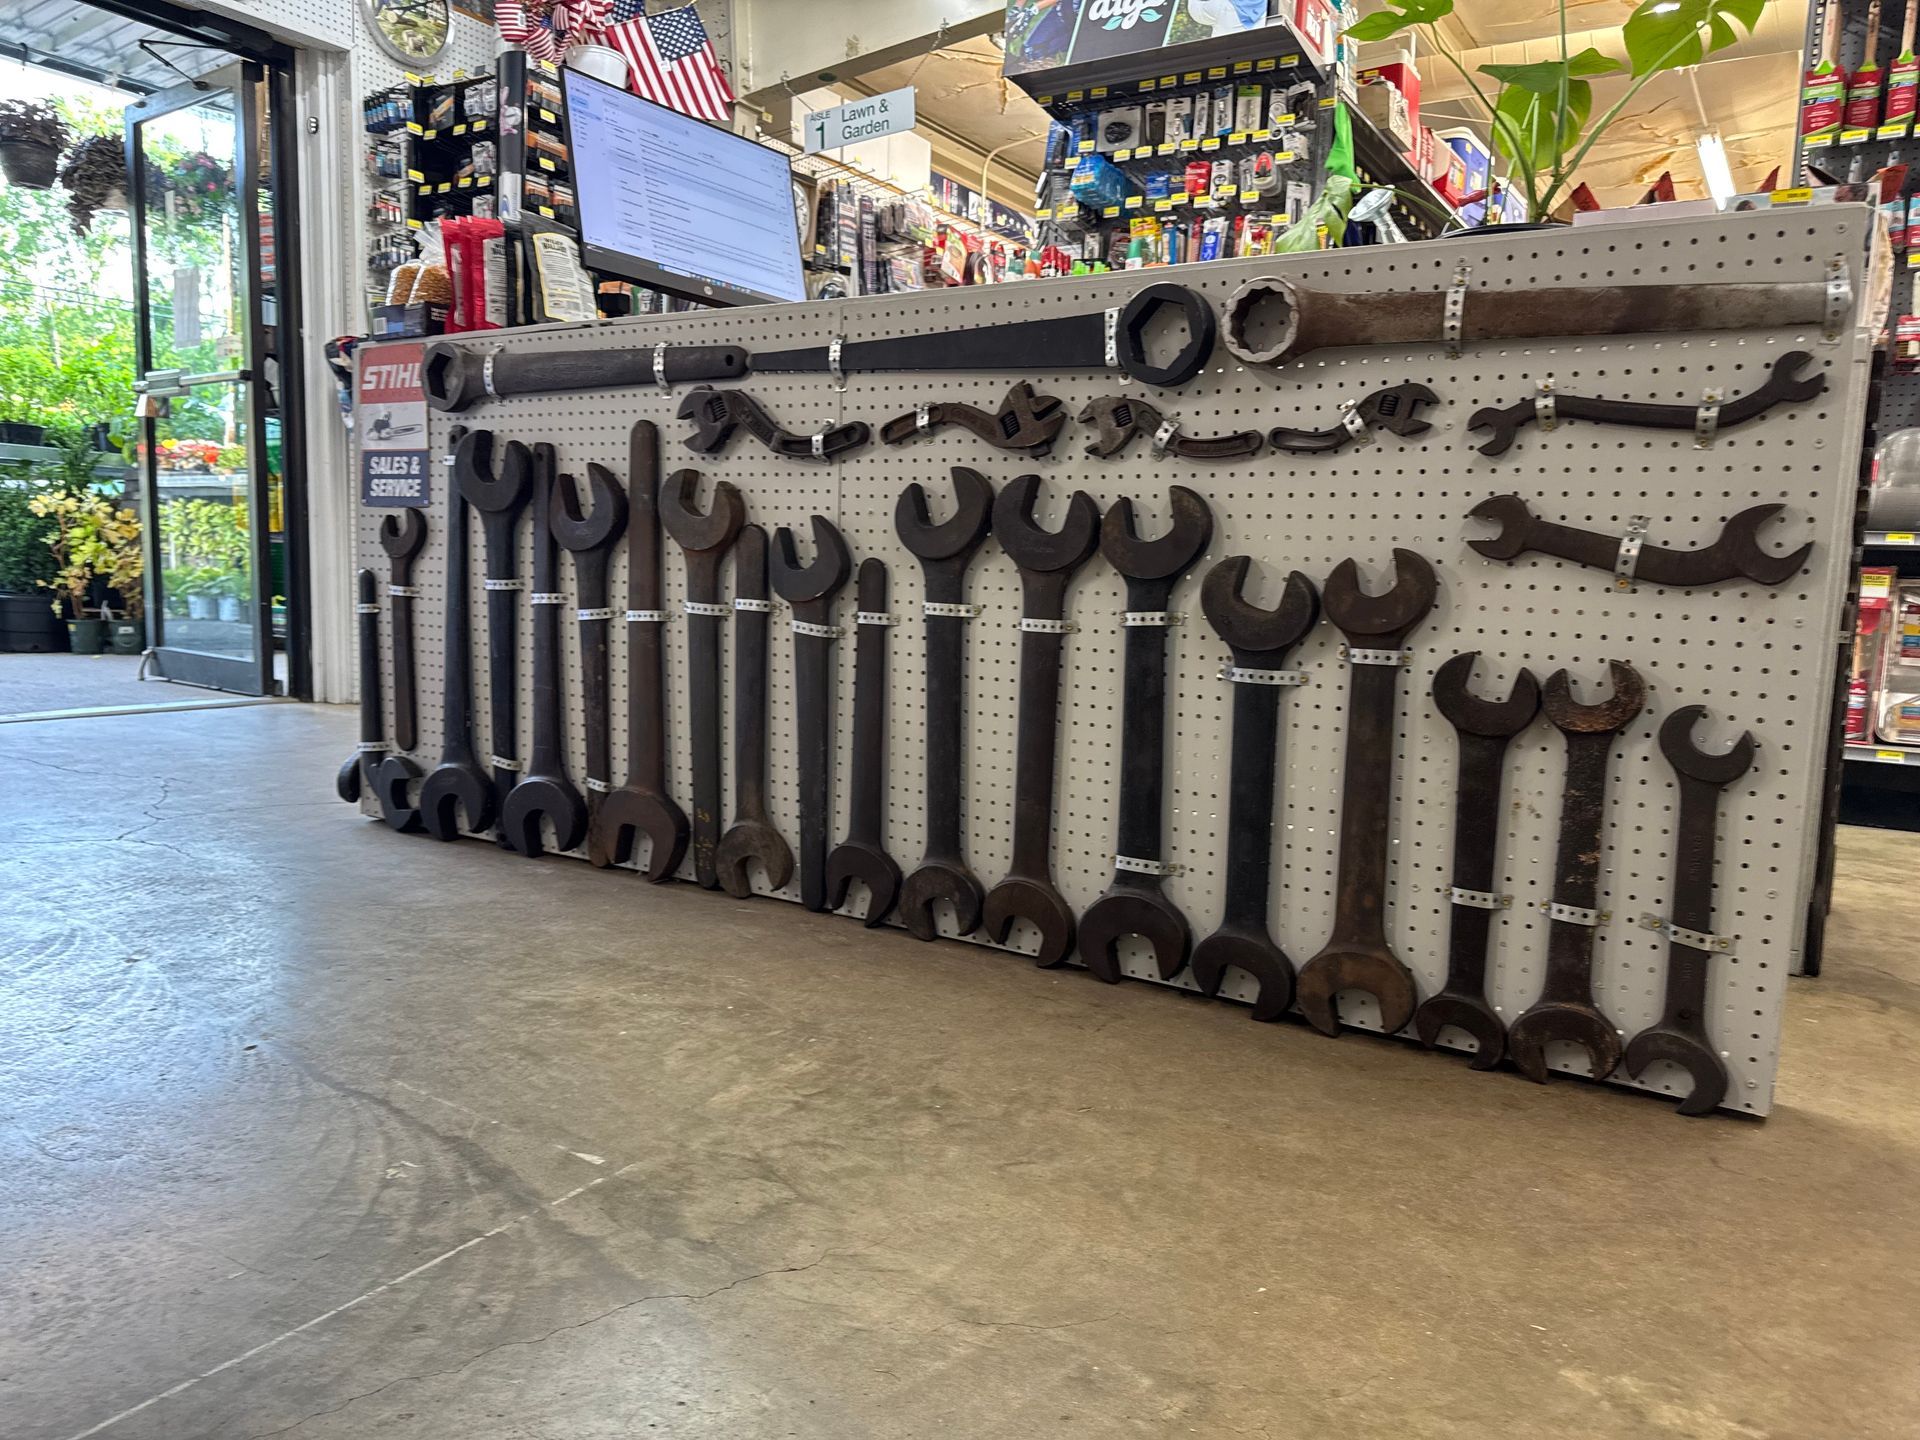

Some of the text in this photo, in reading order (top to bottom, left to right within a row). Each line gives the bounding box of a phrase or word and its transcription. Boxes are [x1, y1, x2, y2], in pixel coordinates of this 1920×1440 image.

[810, 110, 831, 121] AISLE
[841, 98, 889, 122] Lawn &
[815, 121, 825, 149] 1
[841, 119, 890, 140] Garden
[362, 363, 422, 390] STIHL
[369, 456, 420, 475] SALES &
[369, 478, 422, 497] SERVICE
